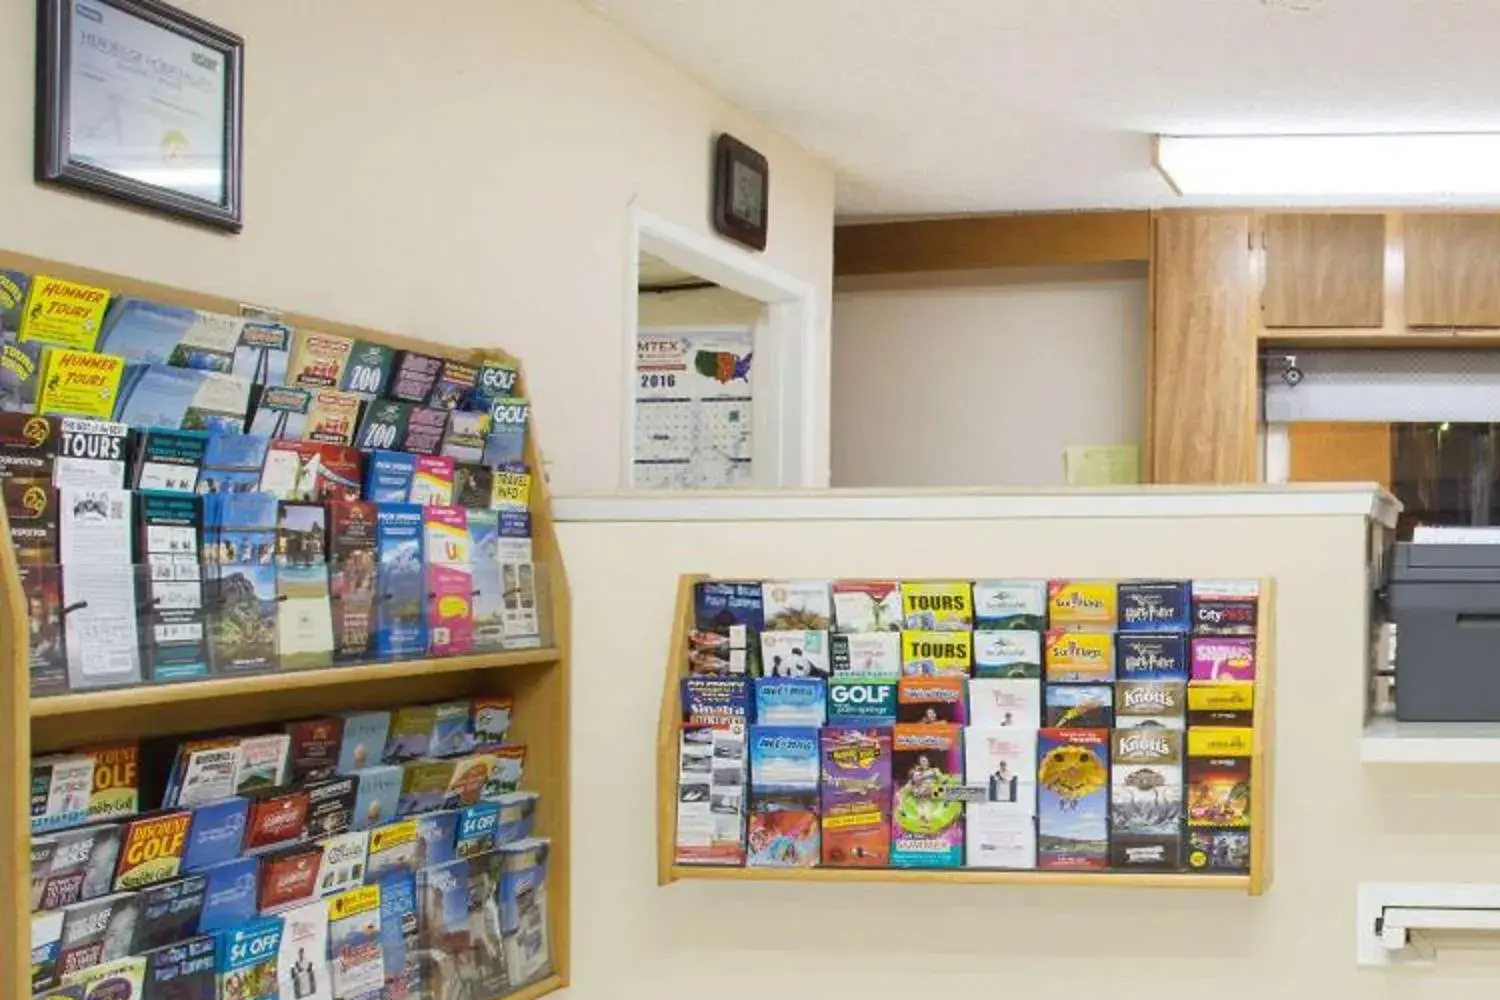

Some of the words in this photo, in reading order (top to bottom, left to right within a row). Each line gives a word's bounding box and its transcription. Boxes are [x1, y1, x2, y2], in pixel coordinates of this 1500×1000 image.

[42, 282, 104, 305] HUMMER
[46, 300, 91, 319] TOURS
[59, 354, 117, 372] HUMMER
[64, 371, 108, 387] TOURS
[482, 371, 516, 389] GOLF
[641, 374, 676, 388] 2016
[493, 404, 530, 424] GOLF
[62, 433, 122, 460] TOURS
[907, 595, 965, 611] TOURS
[911, 642, 968, 659] TOURS
[831, 685, 890, 703] GOLF
[1124, 687, 1175, 707] Knott's
[1119, 735, 1170, 755] Knott's
[96, 763, 136, 790] OLF
[135, 816, 187, 843] DISCOUNT
[128, 831, 185, 865] GOLF
[231, 942, 247, 962] $4
[249, 933, 280, 955] OFF
